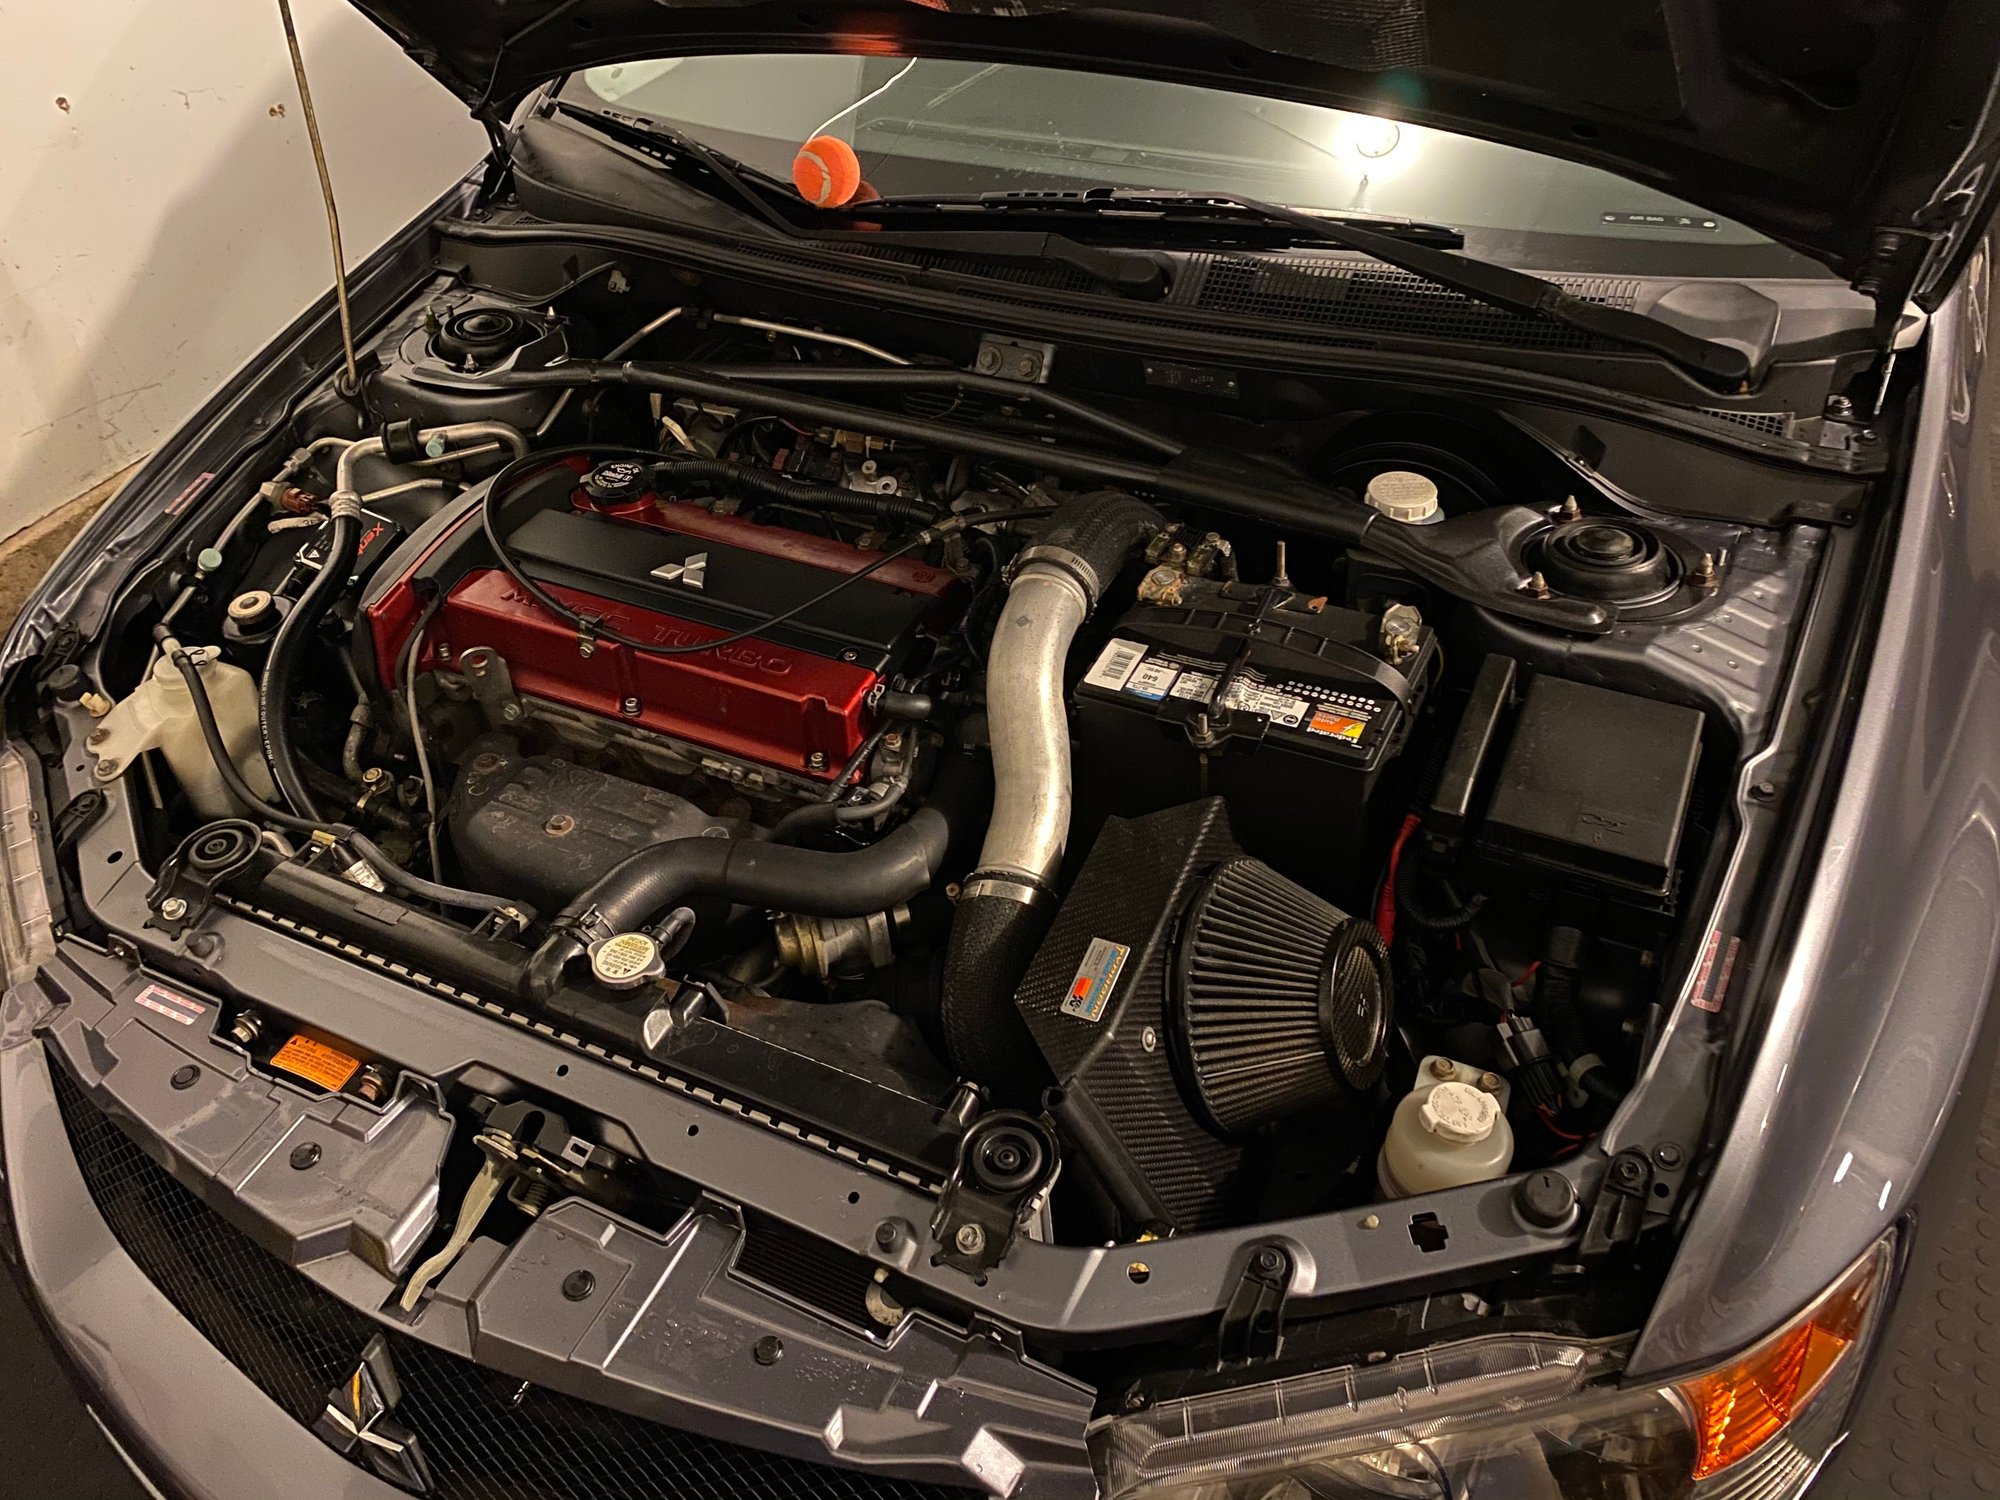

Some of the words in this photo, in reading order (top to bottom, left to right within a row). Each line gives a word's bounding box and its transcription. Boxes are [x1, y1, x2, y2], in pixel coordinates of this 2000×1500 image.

[1142, 673, 1159, 682] 640
[1314, 717, 1335, 726] Auto
[1306, 726, 1358, 744] Federated
